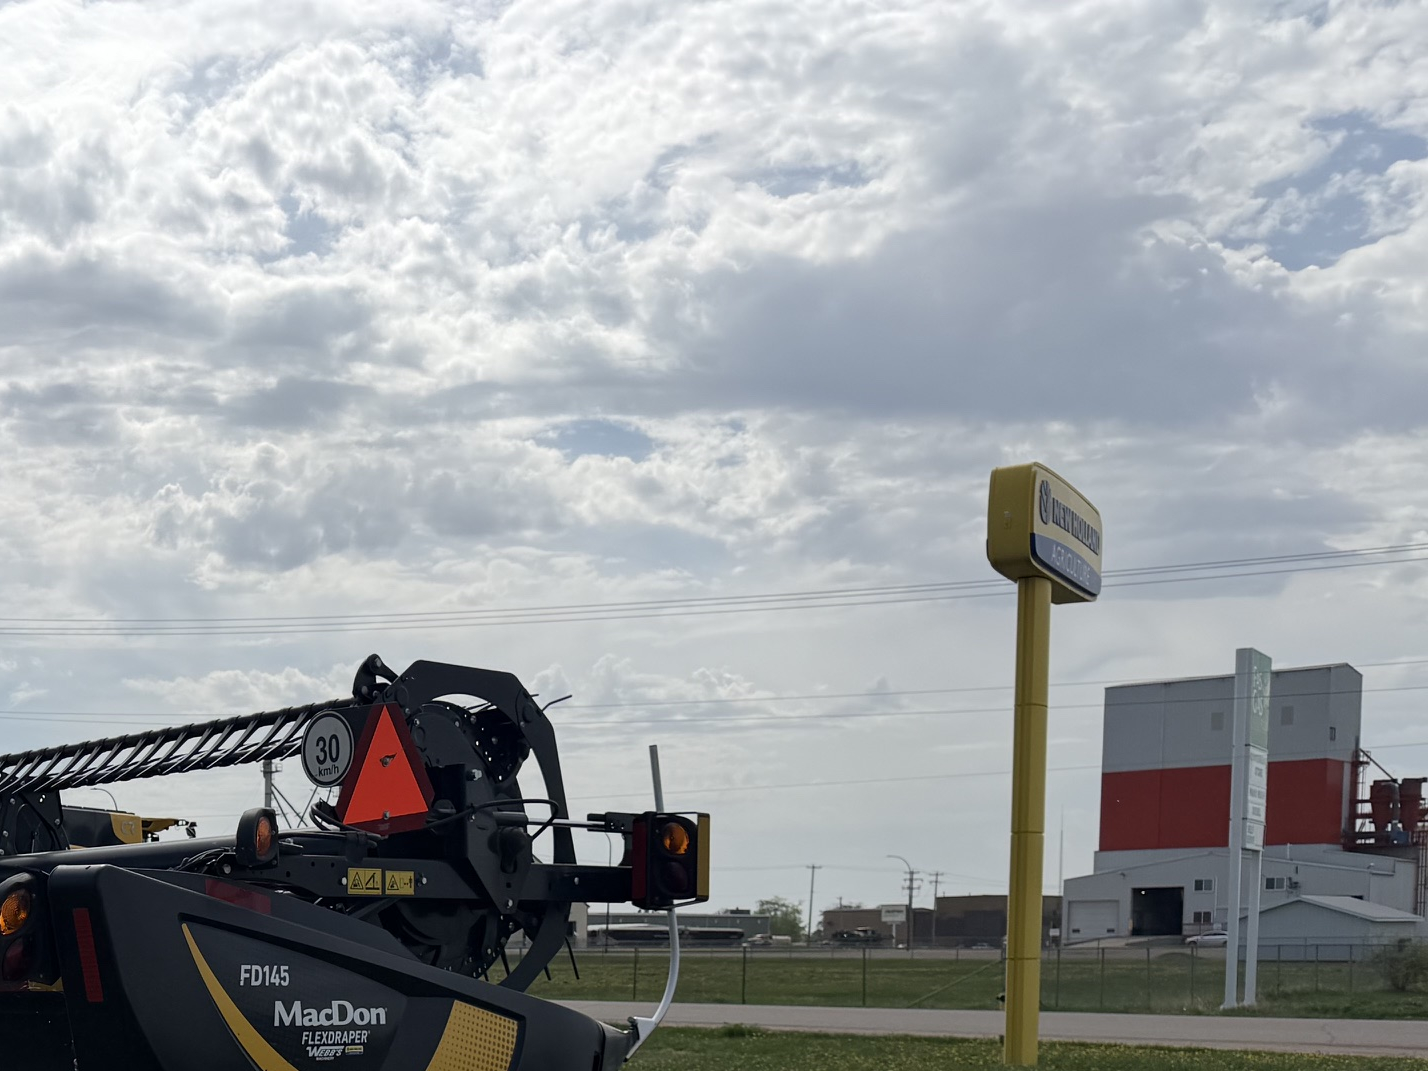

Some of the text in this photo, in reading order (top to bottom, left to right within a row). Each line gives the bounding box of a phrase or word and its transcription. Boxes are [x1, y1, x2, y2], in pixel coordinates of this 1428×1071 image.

[1052, 497, 1100, 556] NEW HOLLAND
[1051, 544, 1091, 586] AGRICULTURE
[315, 733, 340, 766] 30
[318, 764, 340, 778] km/h
[239, 964, 290, 987] FD145
[273, 1000, 387, 1027] MacDon
[301, 1030, 370, 1045] FLEXDRAPER
[305, 1045, 345, 1057] WEBB'S
